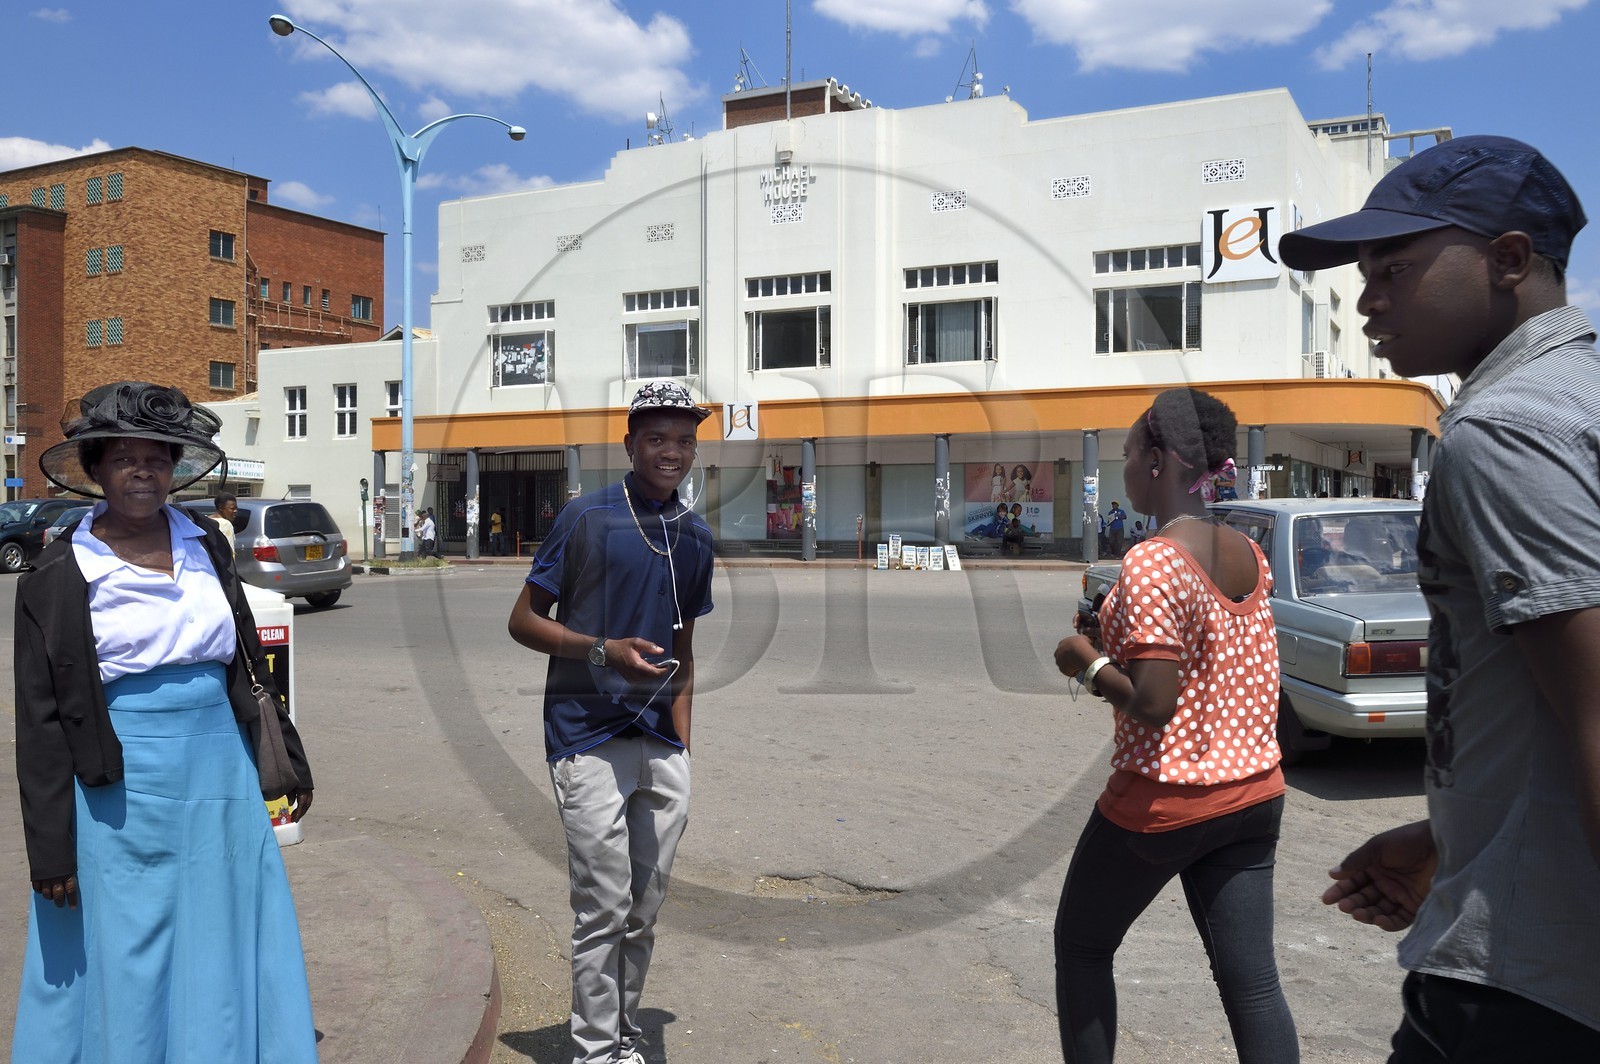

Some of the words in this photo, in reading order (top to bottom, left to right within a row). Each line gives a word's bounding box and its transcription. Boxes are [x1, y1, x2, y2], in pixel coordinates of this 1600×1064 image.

[760, 164, 816, 184] MICHAEL
[764, 182, 808, 201] HOUSE
[261, 628, 285, 641] CLEAN
